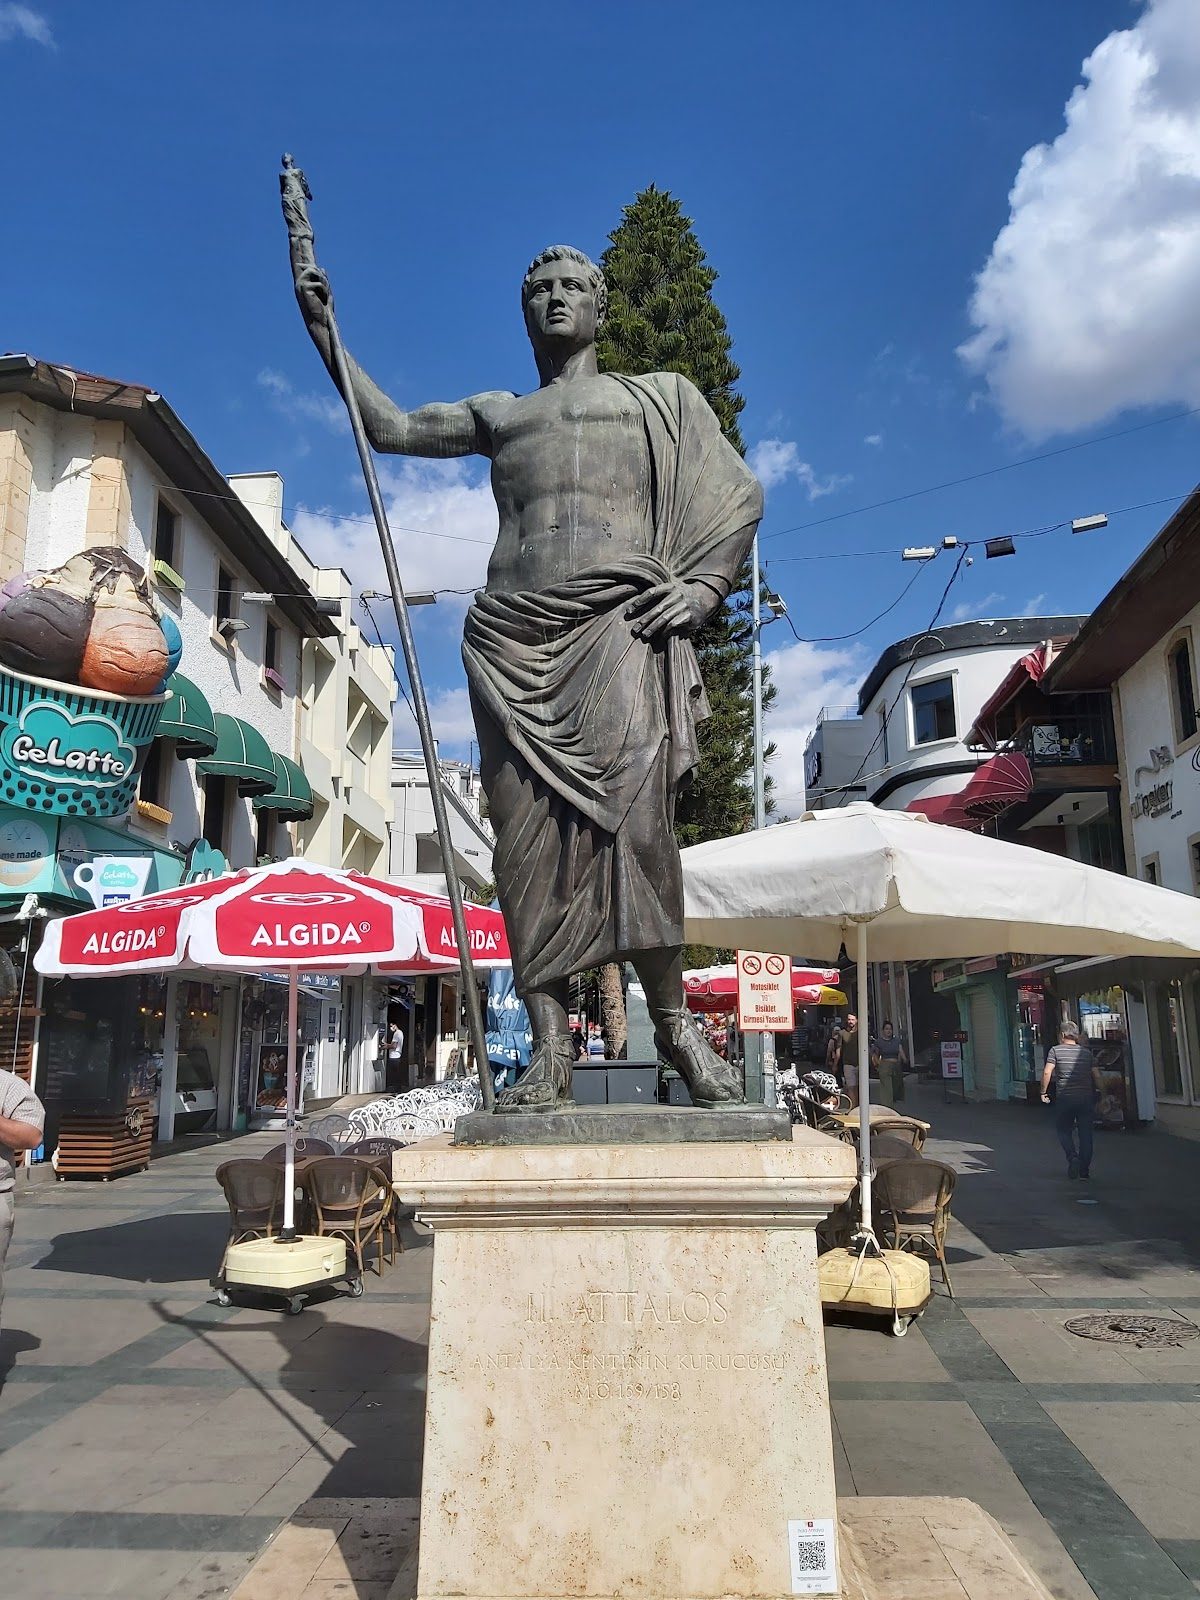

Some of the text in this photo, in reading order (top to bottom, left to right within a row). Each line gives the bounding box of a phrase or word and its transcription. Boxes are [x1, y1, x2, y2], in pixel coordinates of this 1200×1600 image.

[16, 849, 42, 859] made
[750, 983, 780, 991] Motosiklet
[755, 1004, 777, 1013] Bisiklet
[743, 1015, 765, 1024] Girmesi
[570, 1290, 729, 1325] ATTALOS
[469, 1353, 562, 1371] ANTALYA
